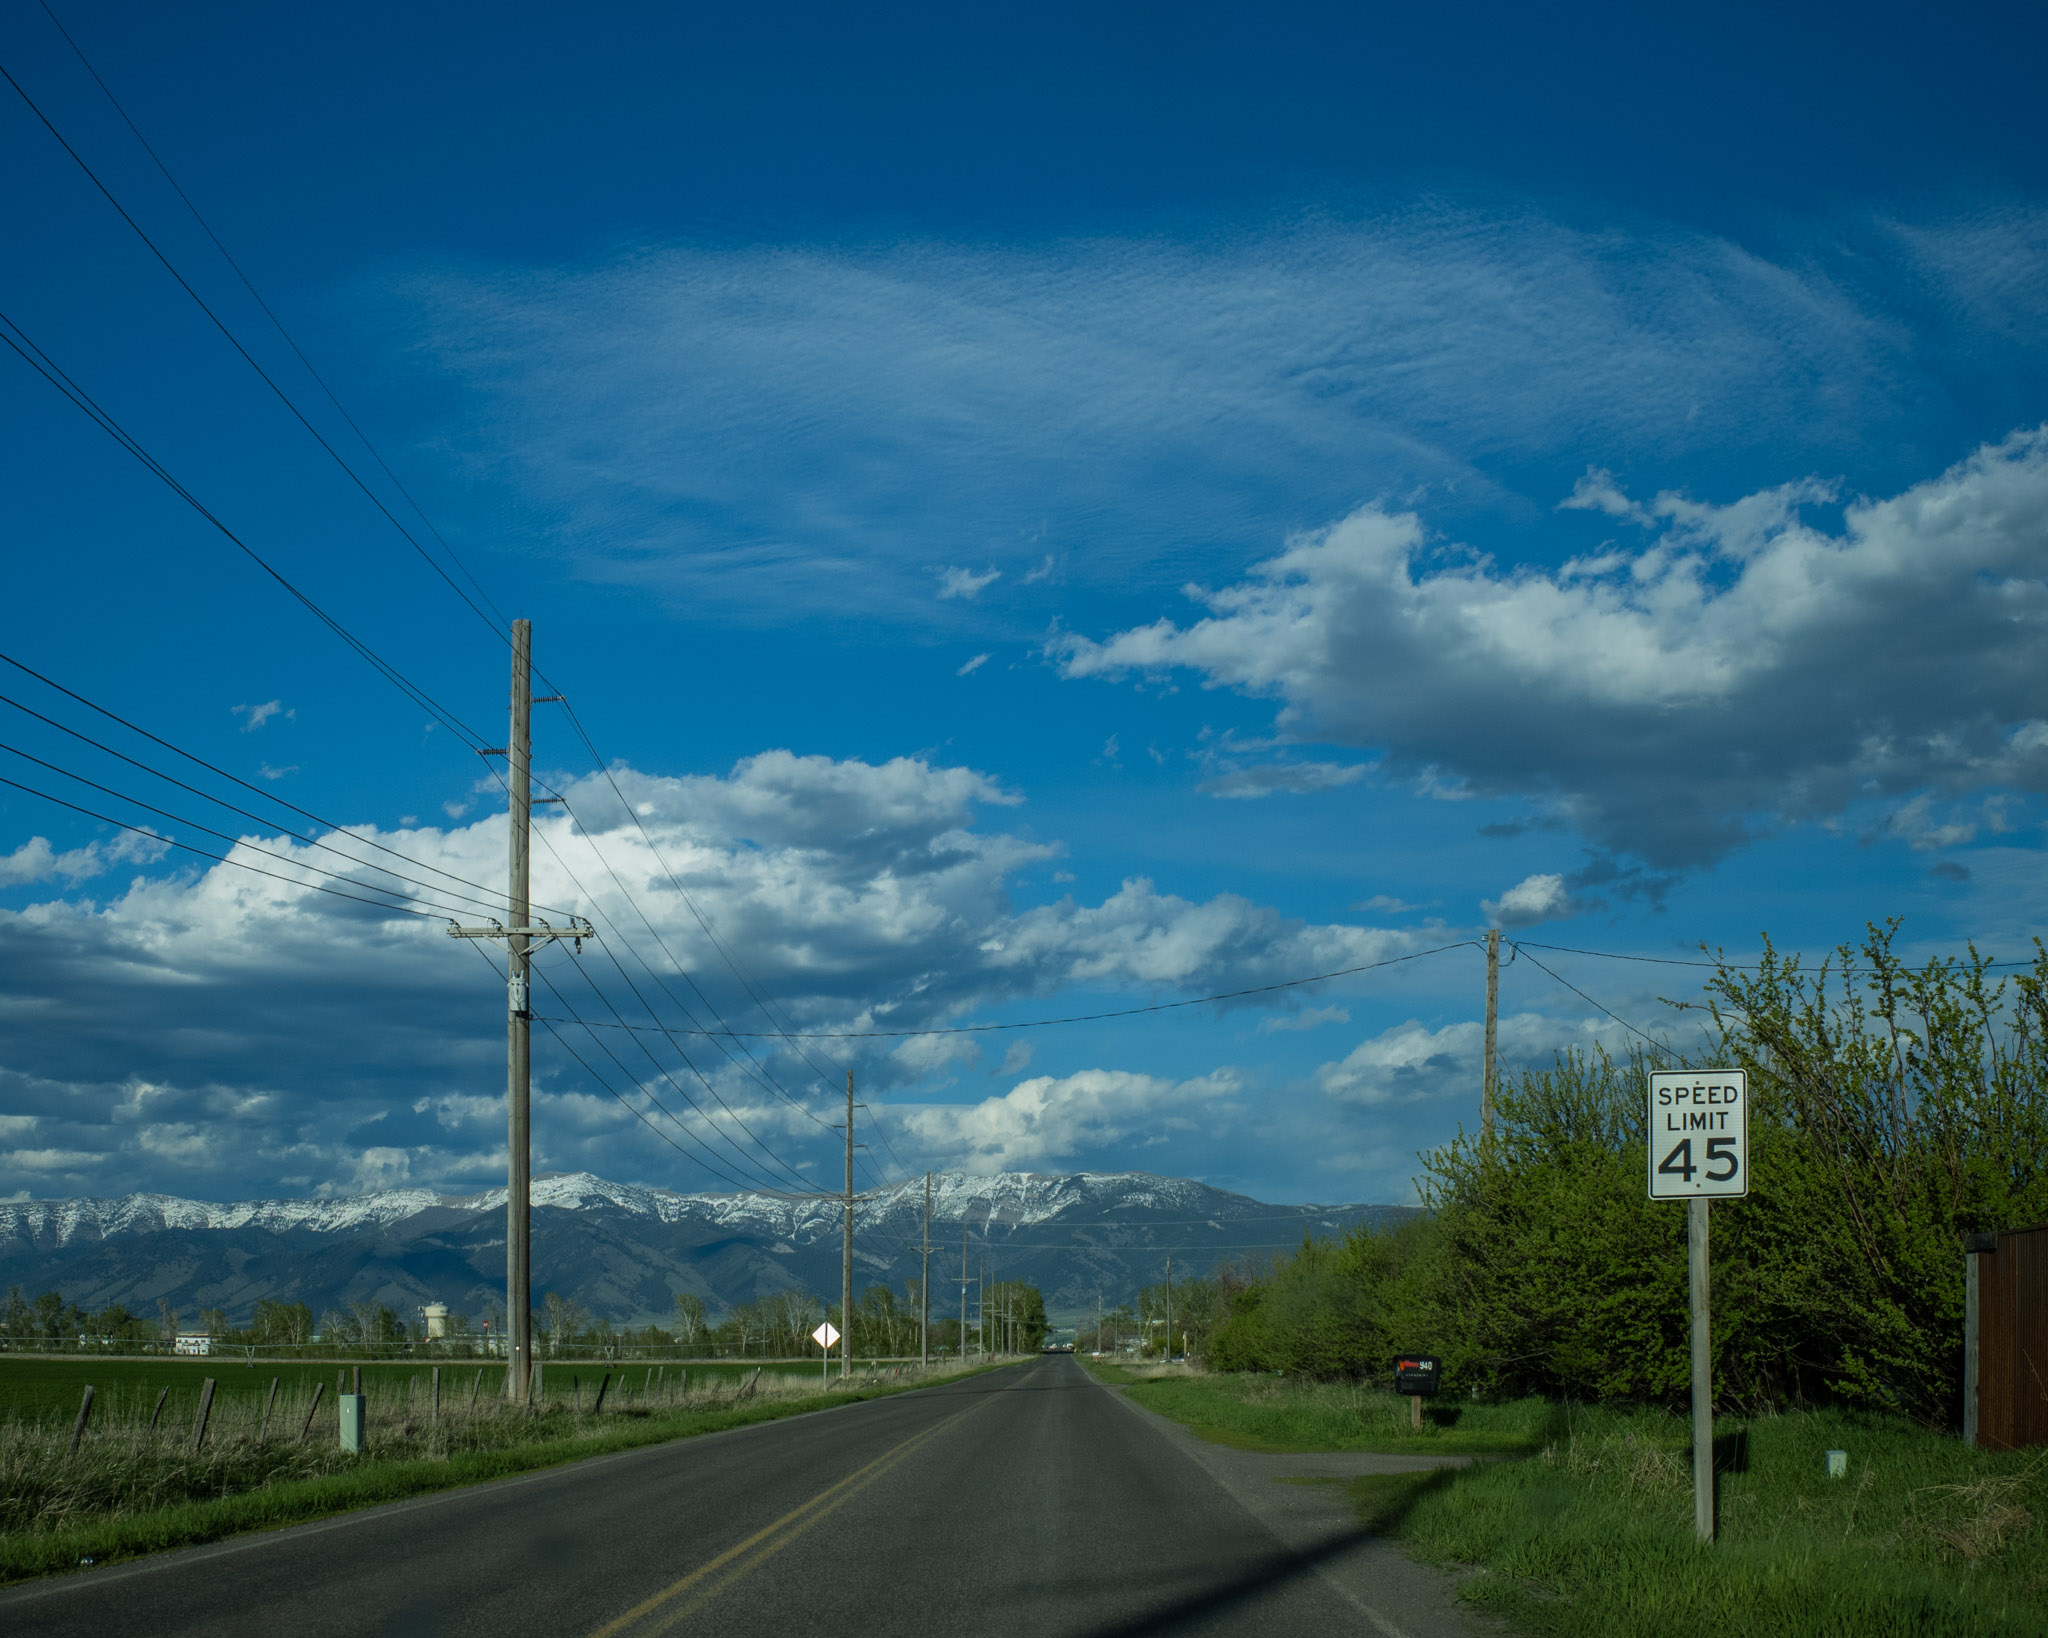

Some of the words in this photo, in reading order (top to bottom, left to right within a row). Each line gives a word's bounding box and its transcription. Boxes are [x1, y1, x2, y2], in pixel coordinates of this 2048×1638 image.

[1658, 1086, 1738, 1105] SPEED
[1667, 1111, 1729, 1131] LIMIT
[1658, 1137, 1738, 1182] 45
